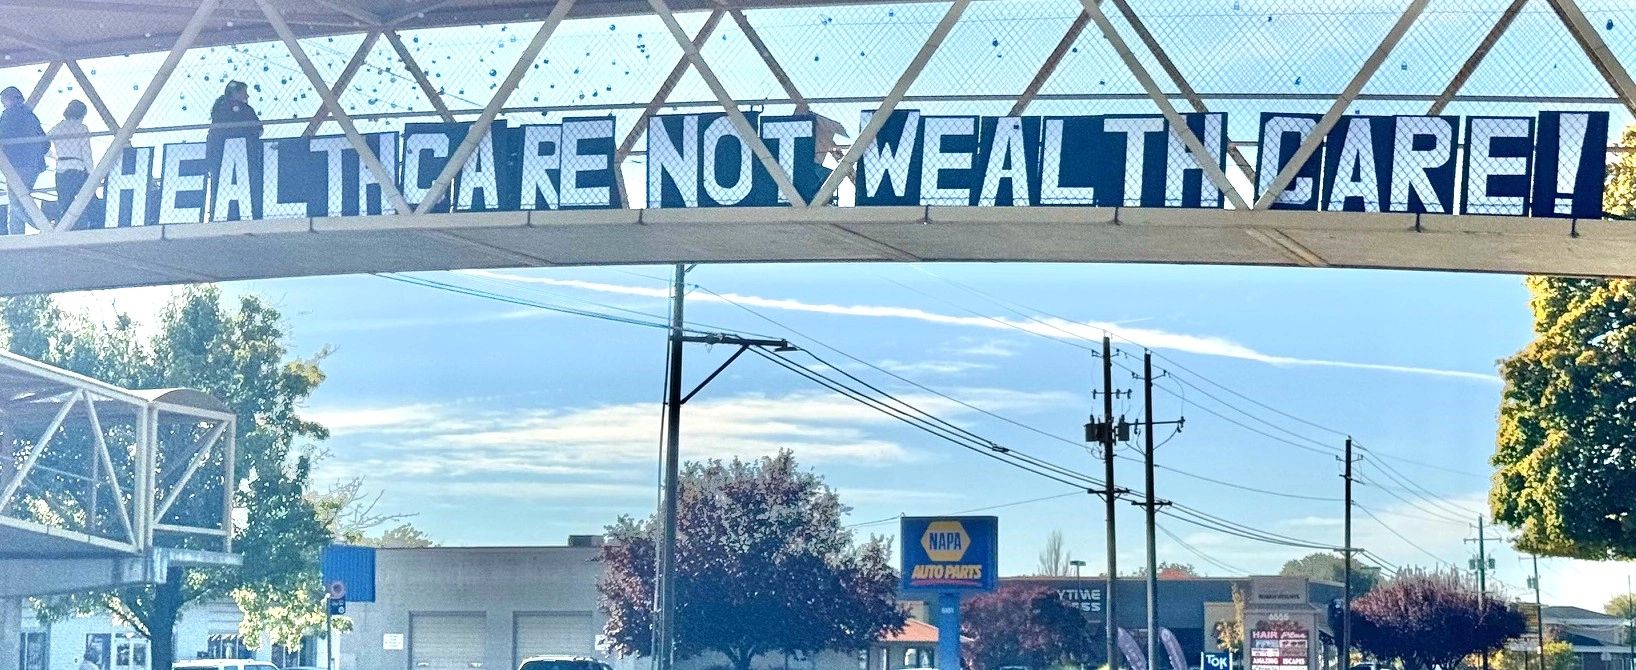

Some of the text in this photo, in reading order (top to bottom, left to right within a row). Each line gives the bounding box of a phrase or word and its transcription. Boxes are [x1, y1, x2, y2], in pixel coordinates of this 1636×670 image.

[648, 114, 813, 208] NOT
[860, 110, 1223, 207] WEALTH
[1258, 112, 1589, 215] CARE!
[929, 532, 962, 551] NAPA
[911, 564, 982, 579] AUTO PARTS
[1057, 589, 1101, 601] YTIME
[1252, 631, 1279, 639] HAIR
[1205, 654, 1228, 669] TOK
[1252, 657, 1279, 665] AMAZING
